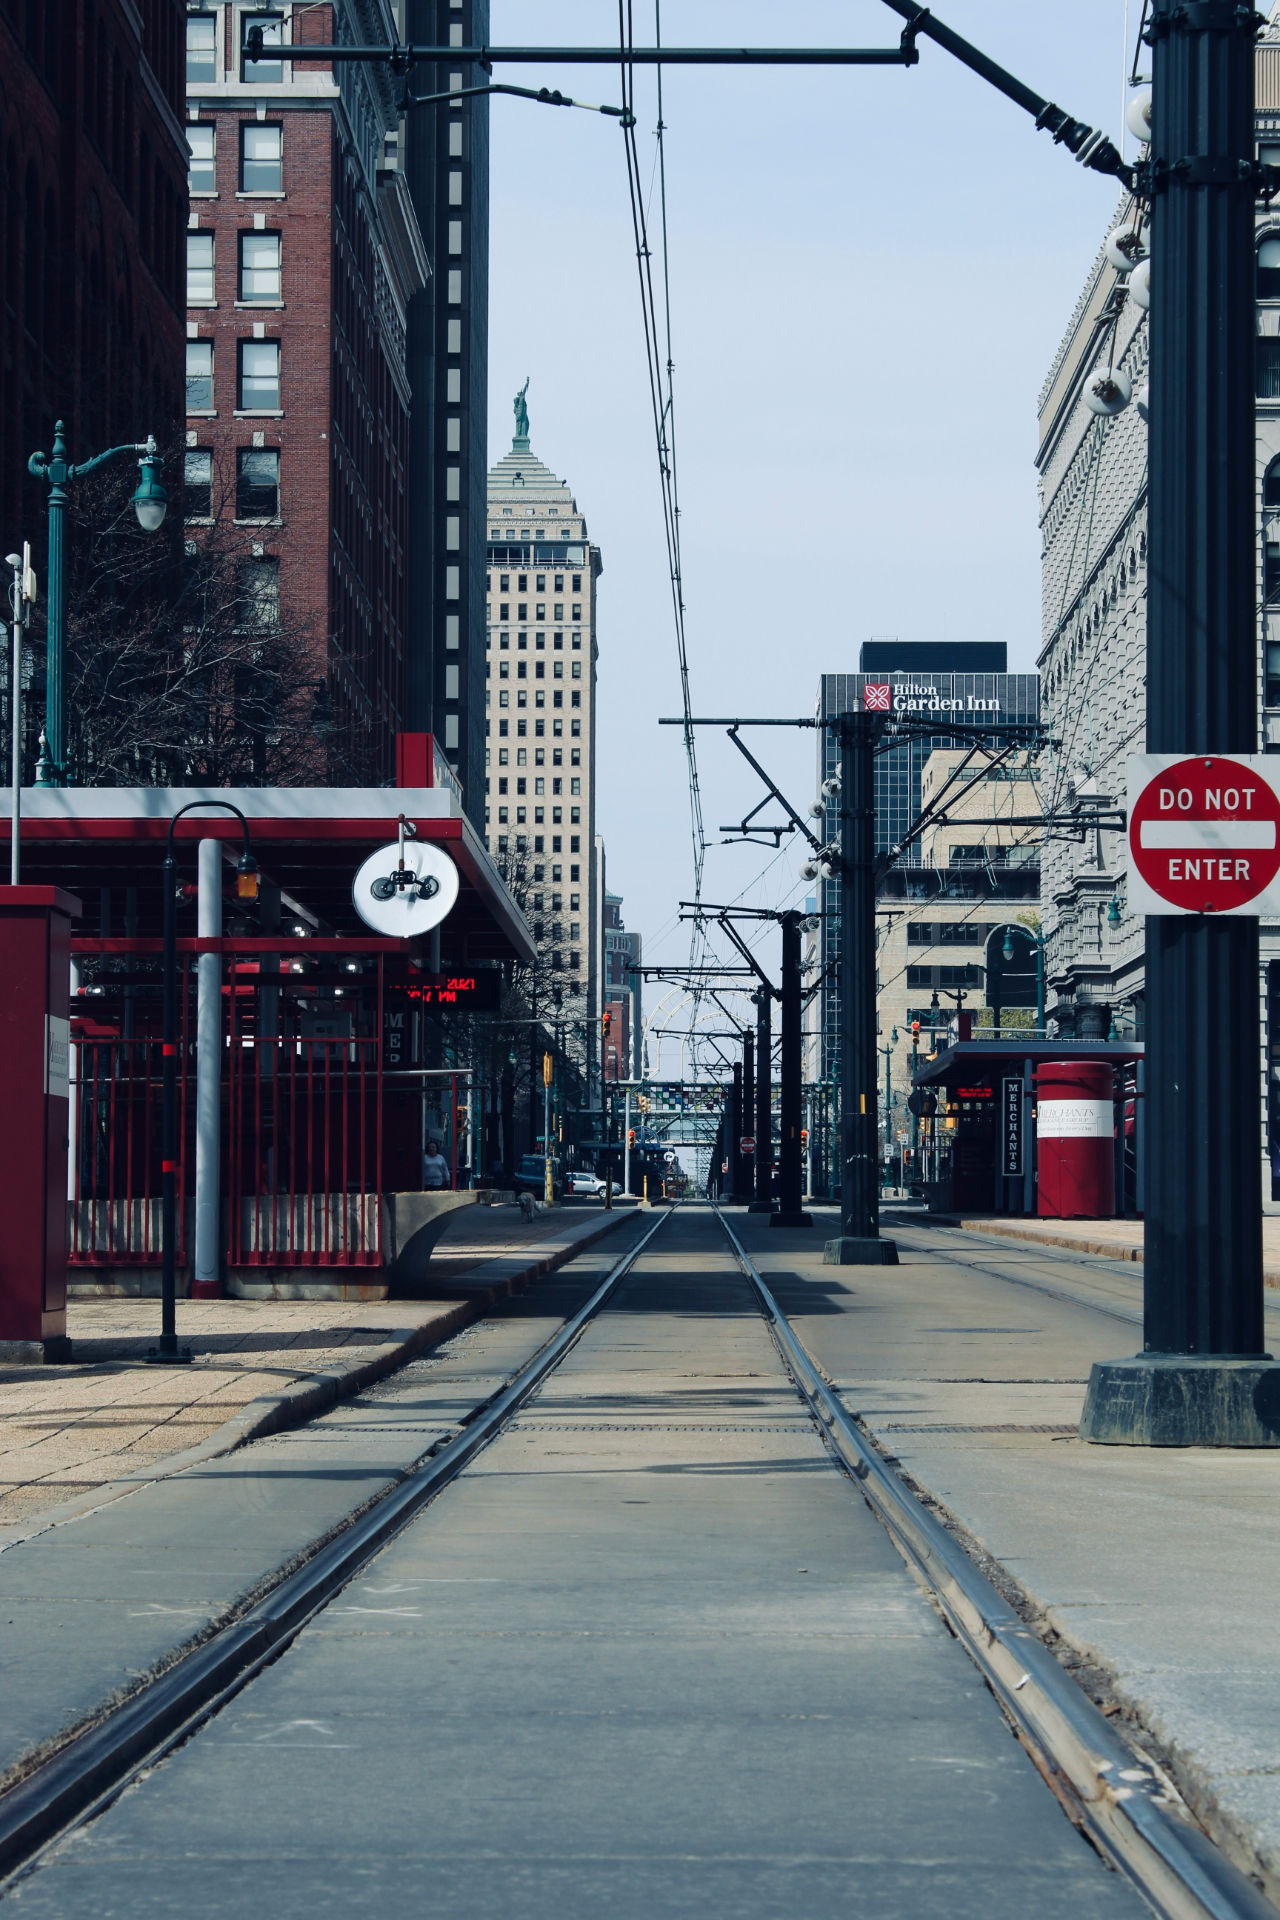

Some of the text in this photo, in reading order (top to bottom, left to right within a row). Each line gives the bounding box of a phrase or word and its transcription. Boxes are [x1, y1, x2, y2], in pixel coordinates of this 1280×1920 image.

[894, 684, 937, 696] Hilton
[893, 695, 1001, 711] Garden Inn
[1159, 788, 1256, 810] DO NOT
[1168, 858, 1250, 881] ENTER
[438, 991, 456, 1002] PM
[1008, 1084, 1019, 1170] MERCHANTS
